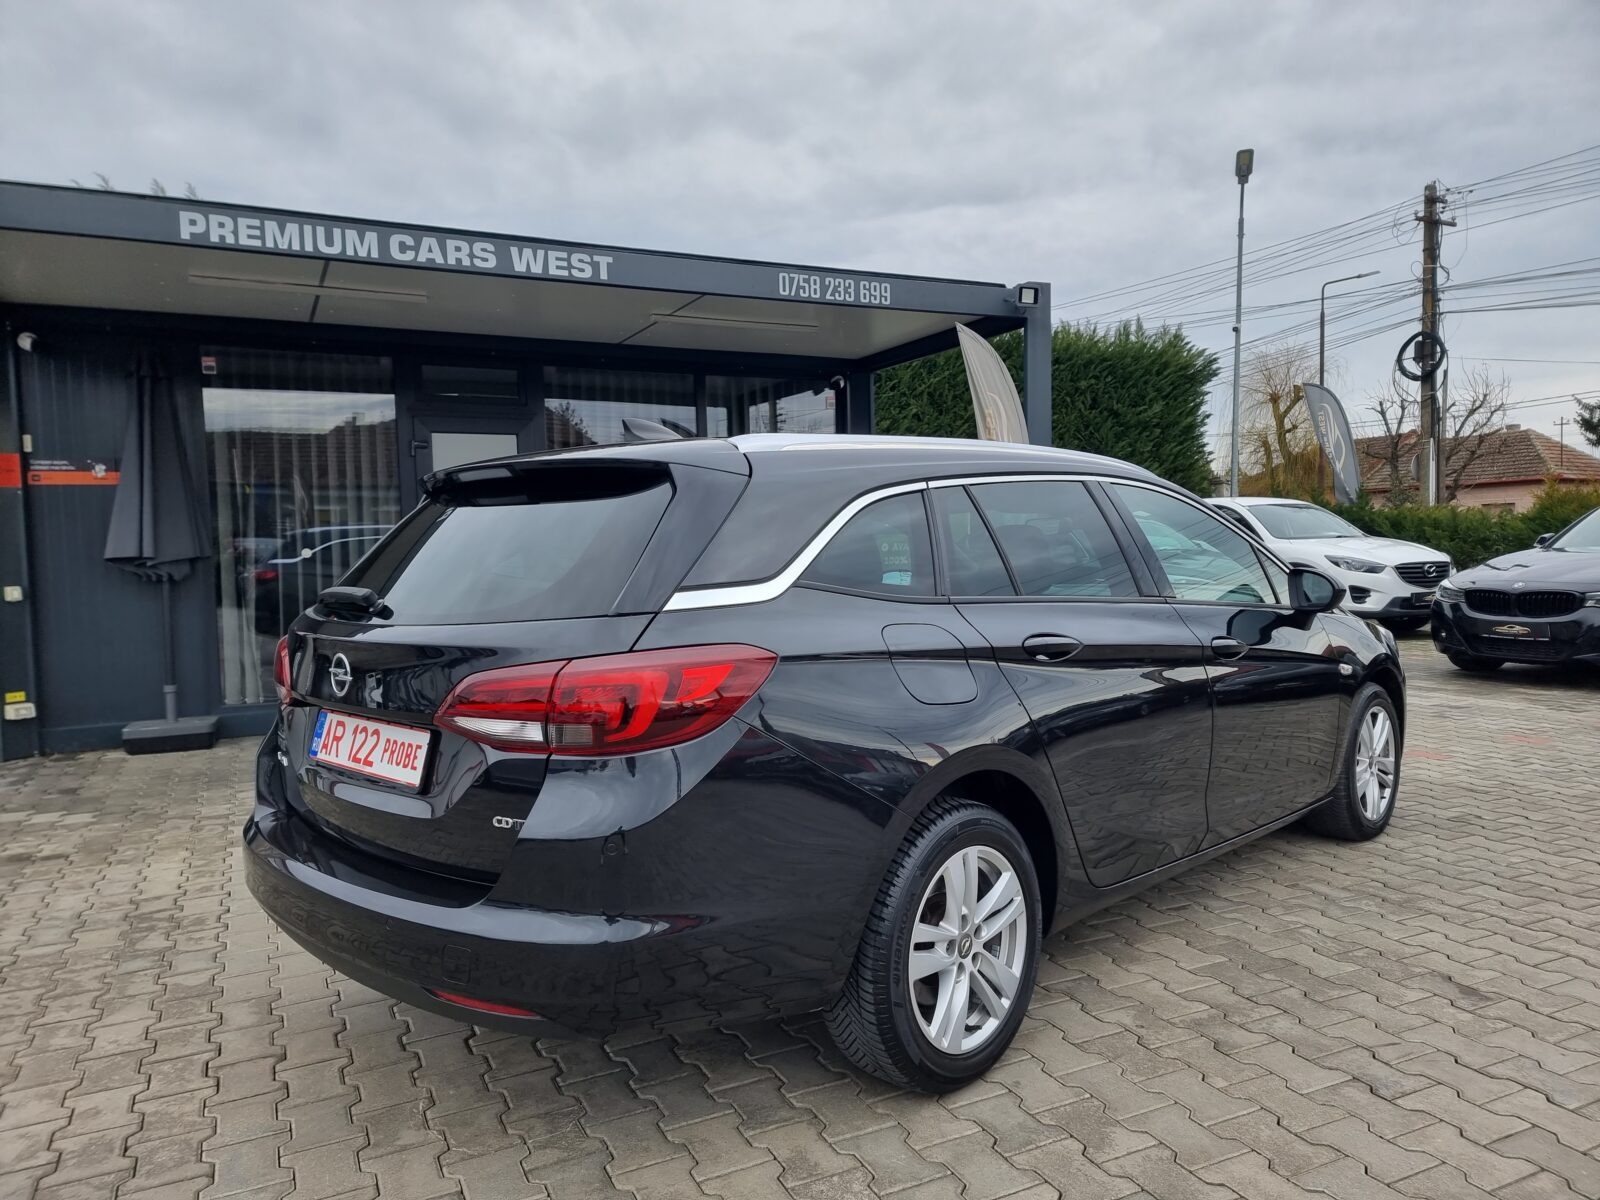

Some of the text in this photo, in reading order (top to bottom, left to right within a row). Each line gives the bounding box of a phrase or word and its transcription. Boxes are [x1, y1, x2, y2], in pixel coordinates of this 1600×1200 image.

[178, 210, 614, 280] PREMIUM CARS WEST
[778, 272, 891, 305] 0758 233 699
[320, 718, 423, 771] AR 122 PROBE
